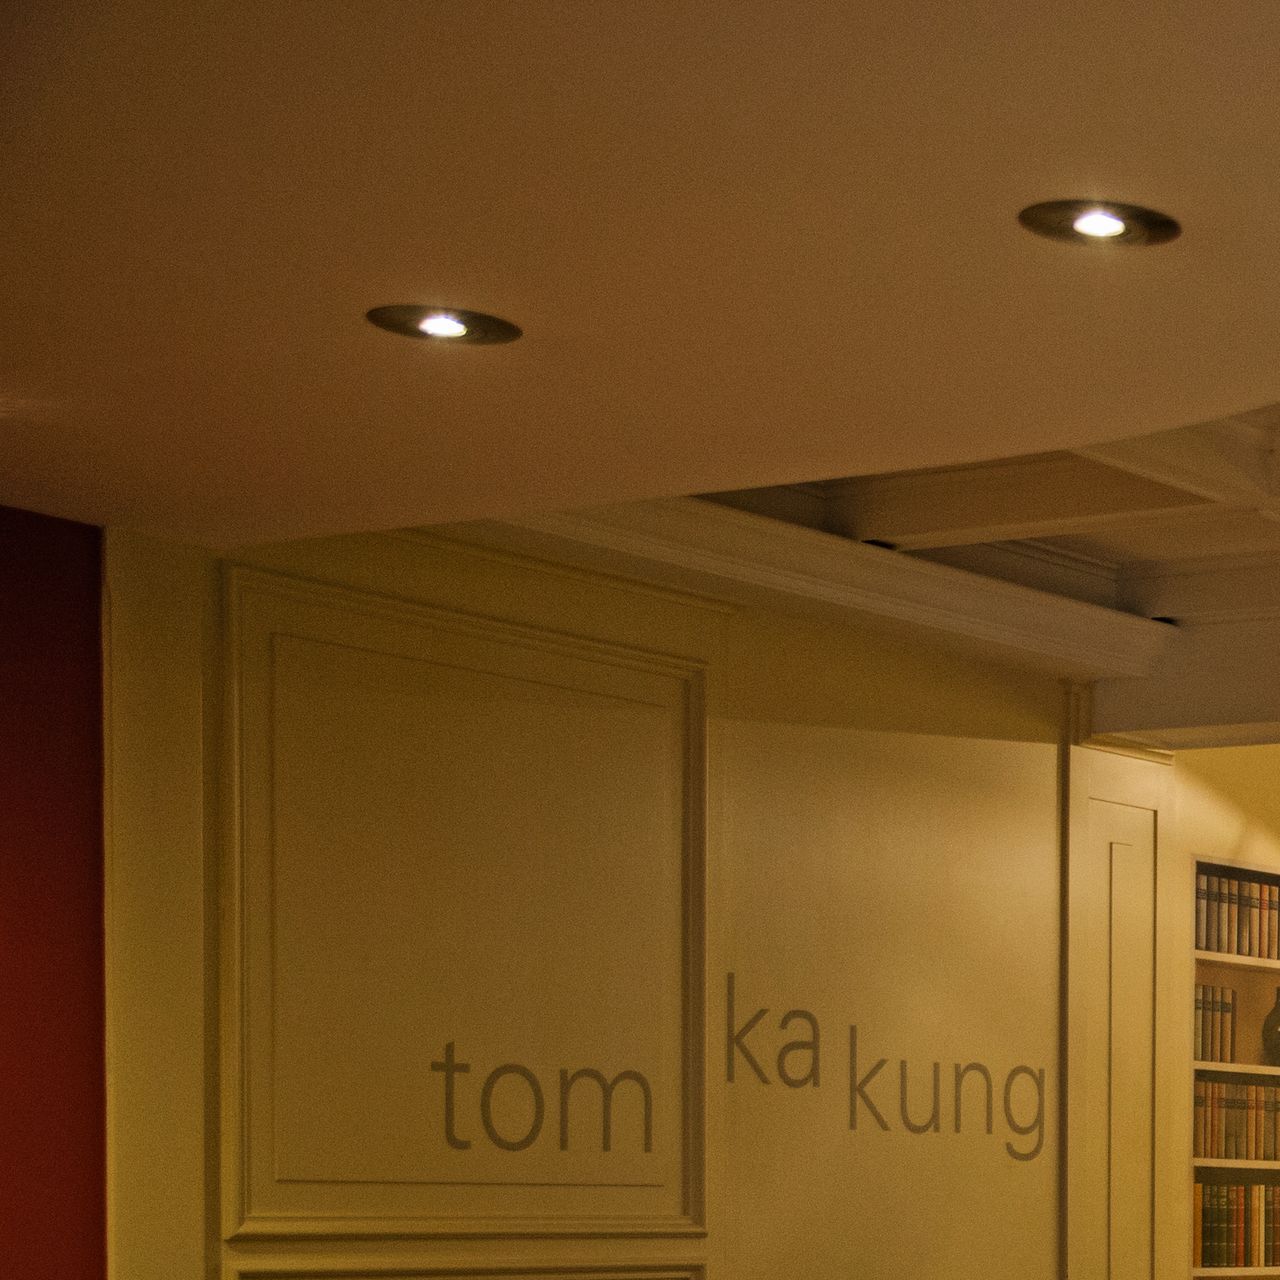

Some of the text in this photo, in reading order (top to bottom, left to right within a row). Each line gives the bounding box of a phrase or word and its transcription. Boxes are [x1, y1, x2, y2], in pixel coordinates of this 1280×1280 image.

[431, 971, 1046, 1161] tom ka kung
